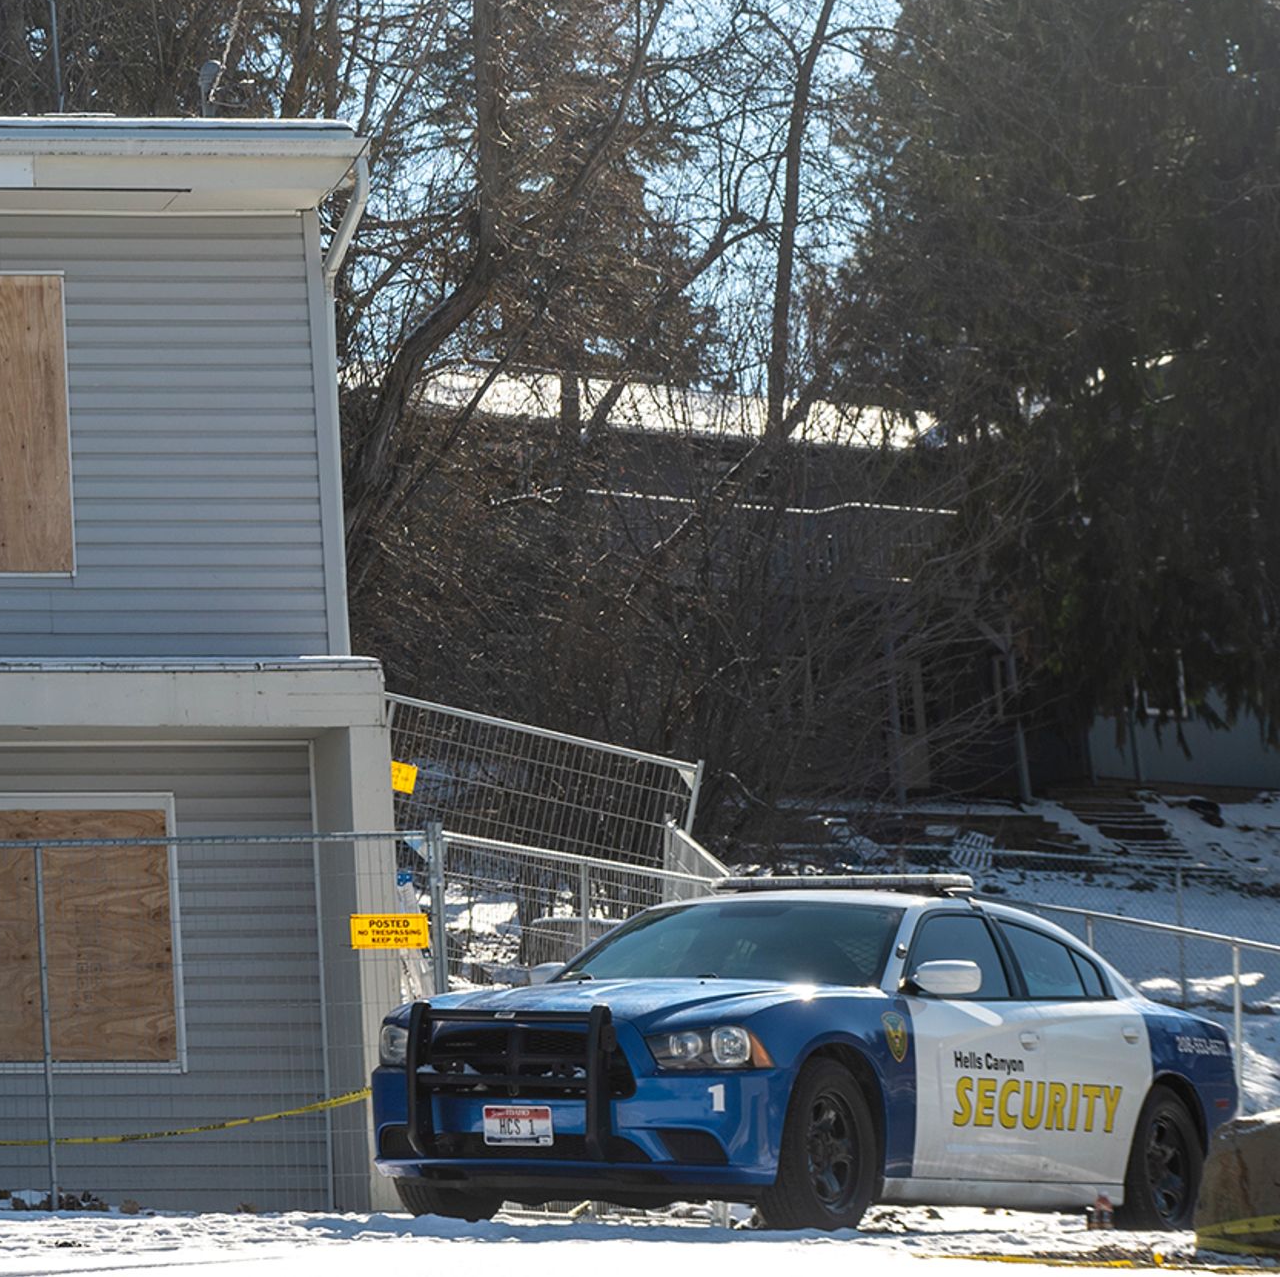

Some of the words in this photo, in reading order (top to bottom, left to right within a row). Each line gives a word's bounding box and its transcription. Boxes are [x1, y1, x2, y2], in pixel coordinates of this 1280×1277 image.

[369, 920, 410, 928] POSTED
[954, 1051, 983, 1070] Hells
[985, 1053, 1025, 1075] Canyon
[707, 1084, 725, 1112] 1
[952, 1076, 1123, 1133] SECURITY
[499, 1118, 521, 1135] HCS
[529, 1119, 536, 1135] 1
